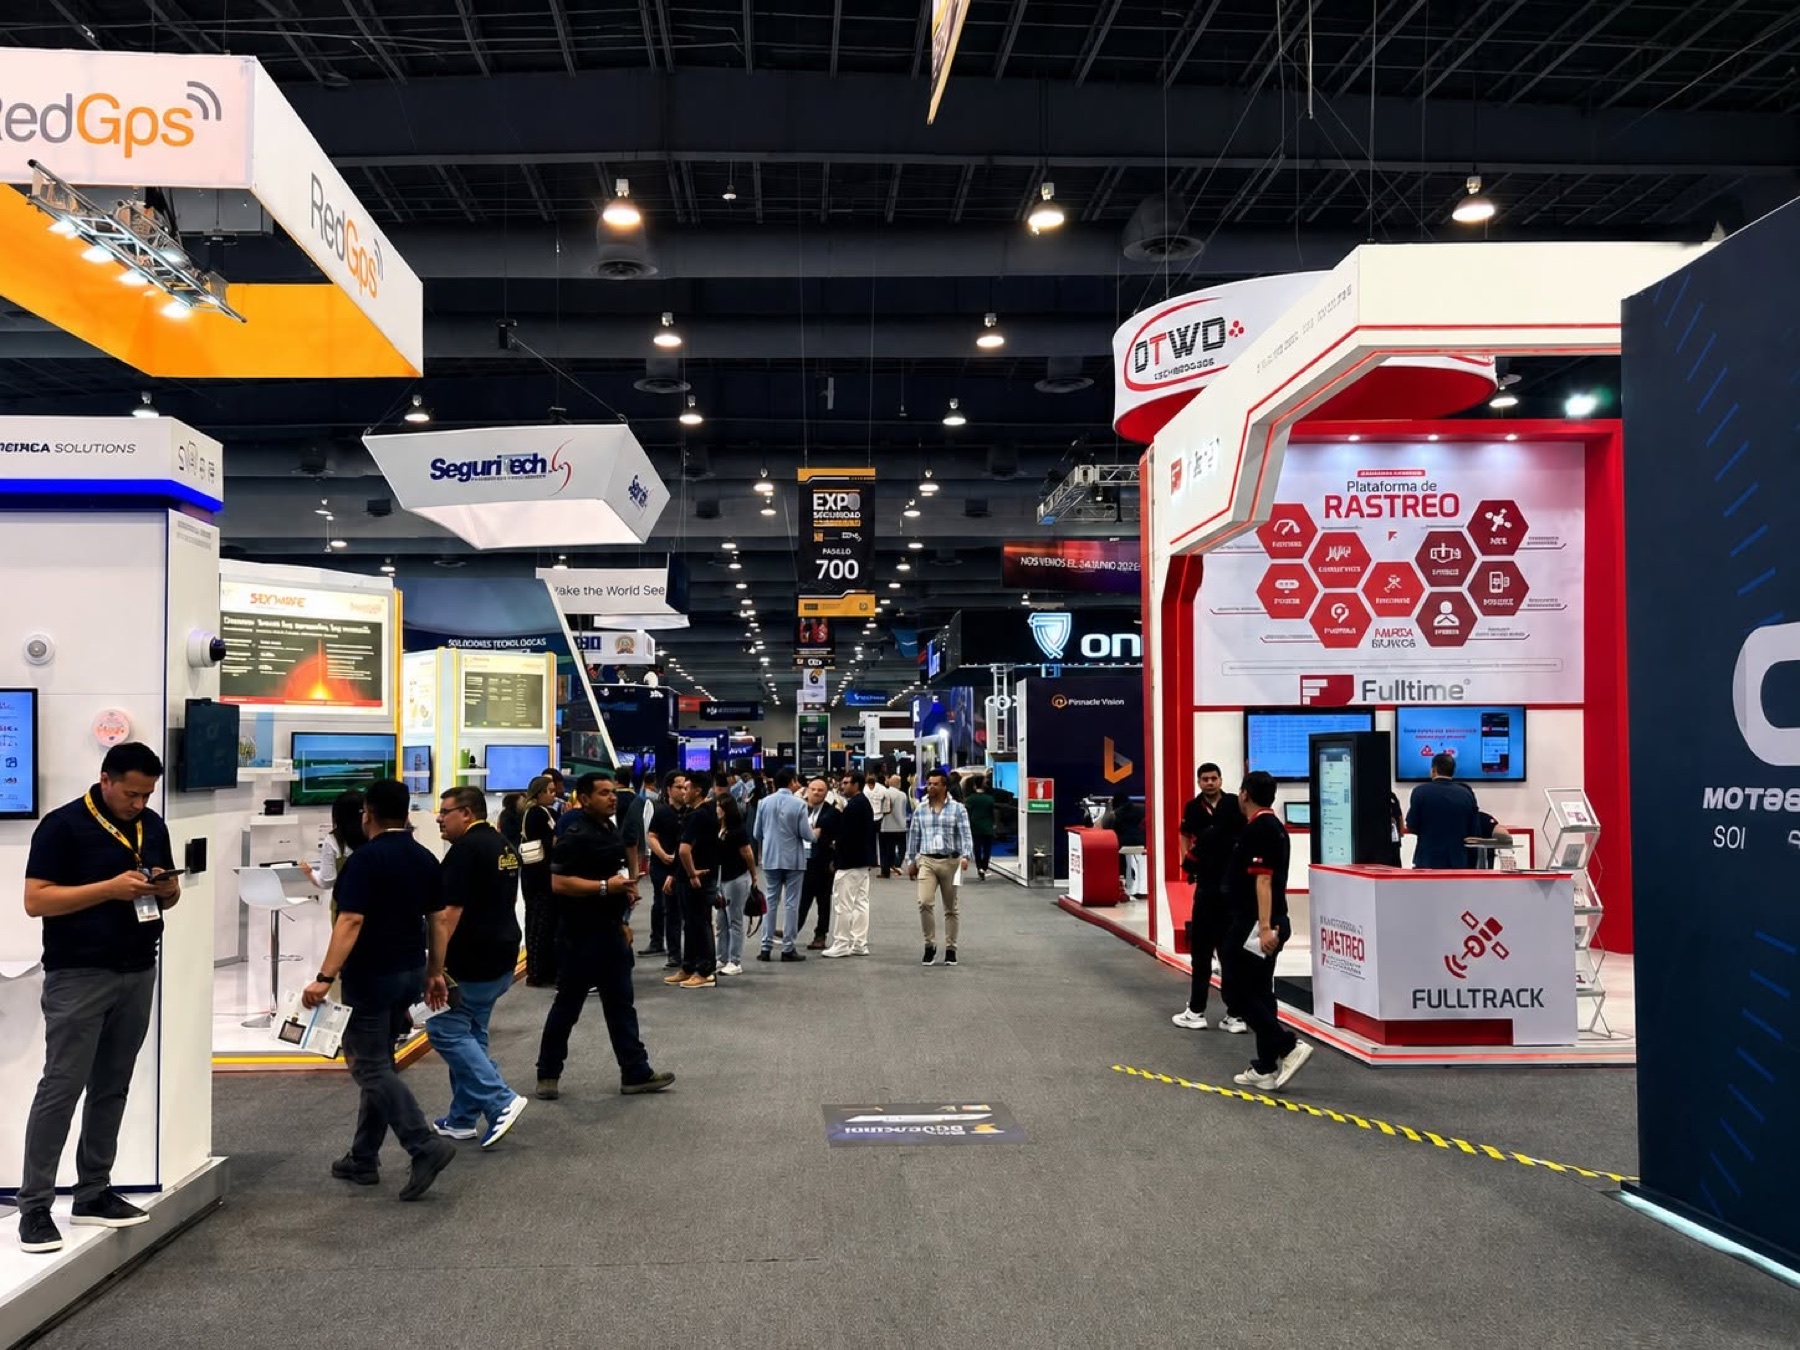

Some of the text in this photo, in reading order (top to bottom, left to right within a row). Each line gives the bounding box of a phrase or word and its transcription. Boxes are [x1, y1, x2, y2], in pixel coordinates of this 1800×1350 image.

[0, 92, 195, 159] edGps
[312, 172, 378, 299] RedGps
[54, 443, 136, 454] SOLUTIONS
[1346, 480, 1438, 493] Plataforma de
[813, 492, 861, 511] EXPO
[1324, 493, 1460, 519] RASTREO
[815, 559, 860, 580] 700
[583, 585, 603, 597] the
[606, 585, 640, 596] World
[643, 585, 665, 596] See
[1080, 632, 1144, 658] on
[1068, 698, 1125, 706] Pinnacle Vision
[1411, 987, 1545, 1009] FULLTRACK
